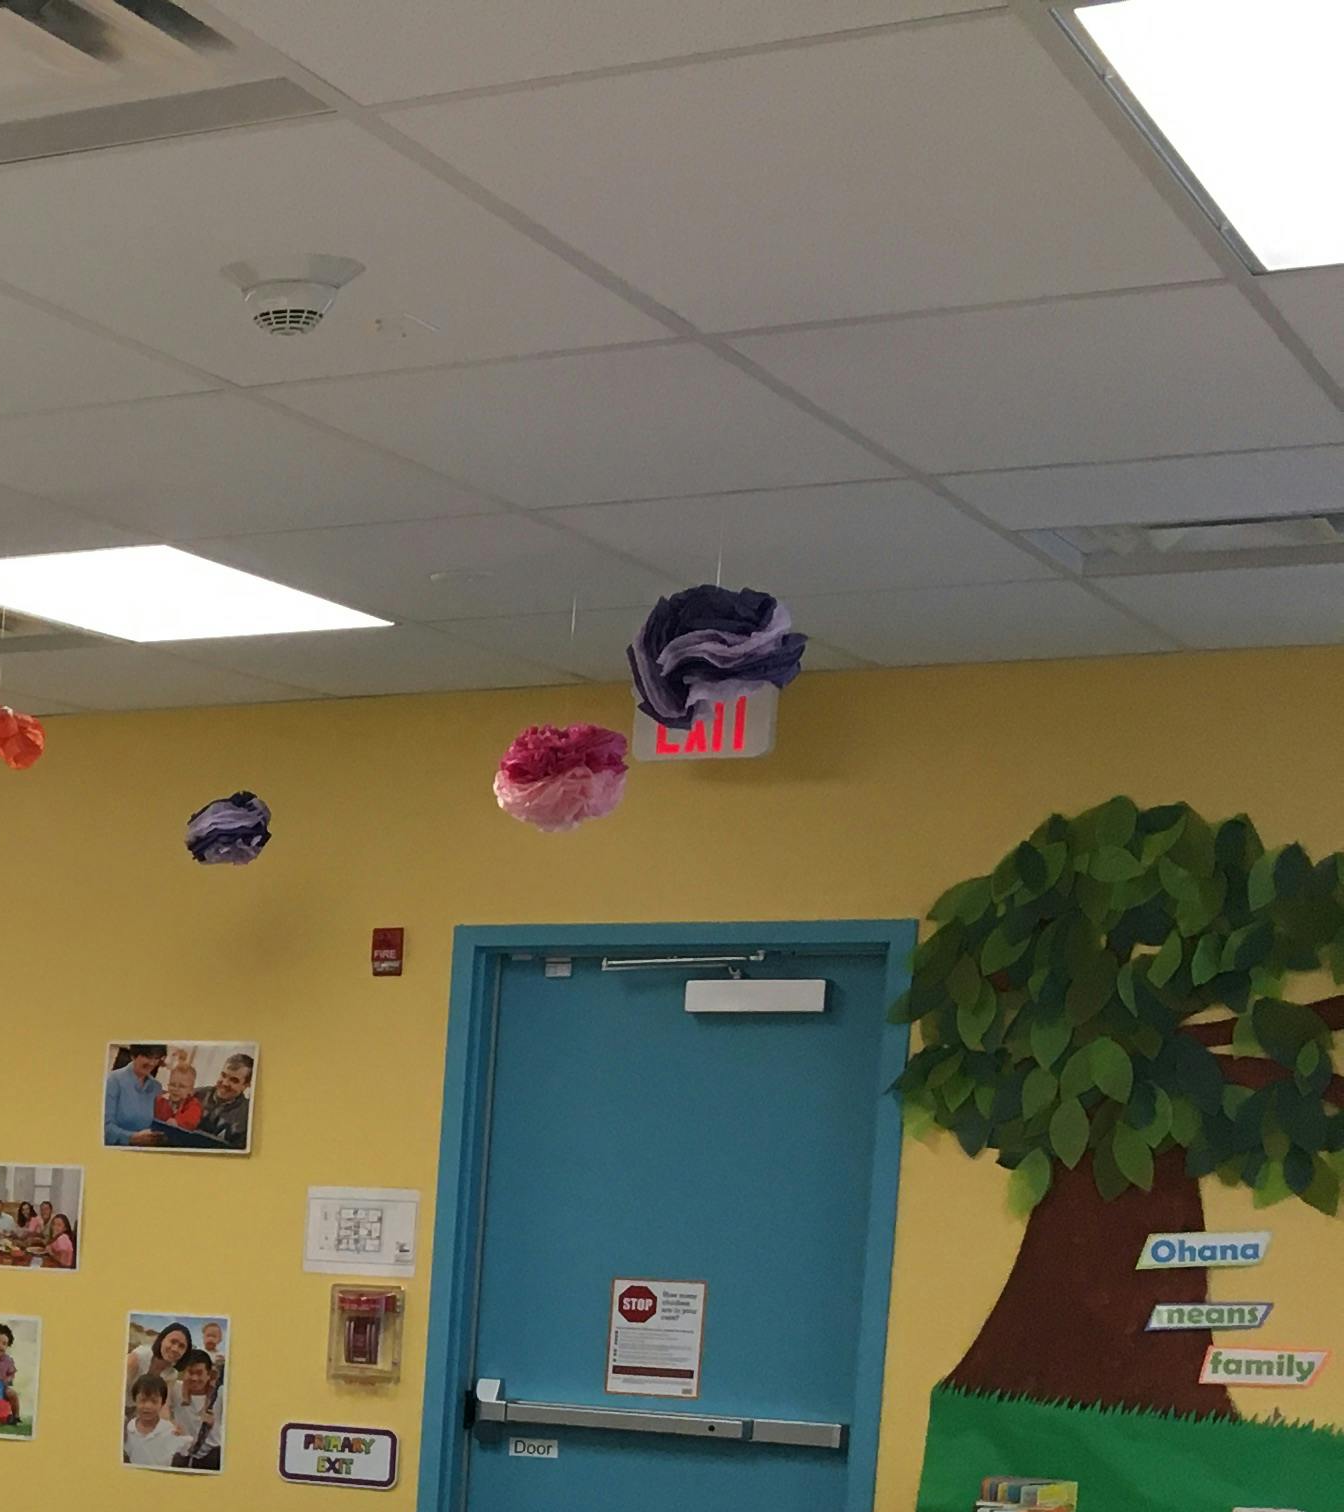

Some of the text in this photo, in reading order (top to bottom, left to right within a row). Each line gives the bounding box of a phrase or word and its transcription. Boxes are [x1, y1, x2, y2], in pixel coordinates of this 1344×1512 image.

[1150, 1239, 1260, 1263] Ohana
[623, 1298, 654, 1311] STOP
[1210, 1351, 1315, 1382] family
[303, 1433, 376, 1456] PRIMARY
[514, 1440, 553, 1455] Door
[316, 1455, 354, 1475] EXIT
